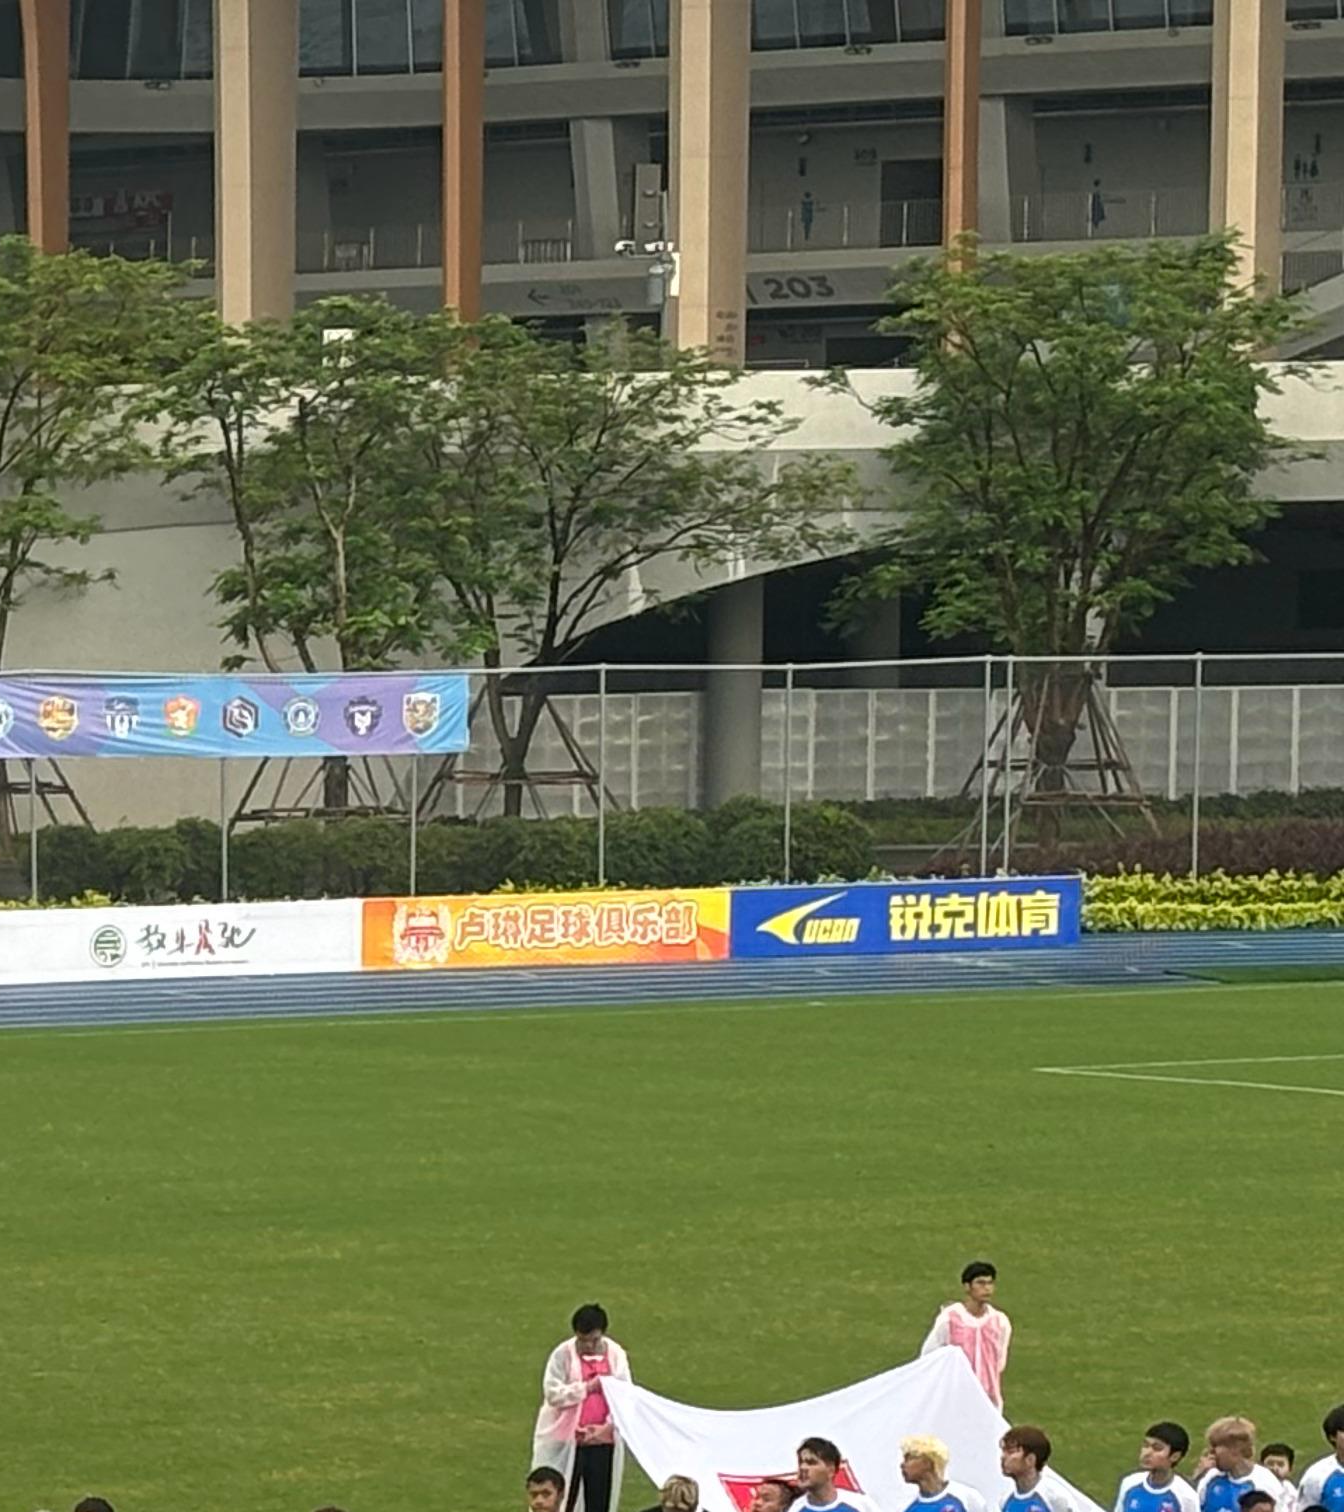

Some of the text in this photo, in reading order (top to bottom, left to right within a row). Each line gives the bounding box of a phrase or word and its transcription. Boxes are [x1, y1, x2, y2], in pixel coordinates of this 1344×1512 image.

[764, 275, 835, 299] 203
[455, 901, 699, 949] 卢琳足球俱乐部
[889, 890, 1060, 941] 锐克体育
